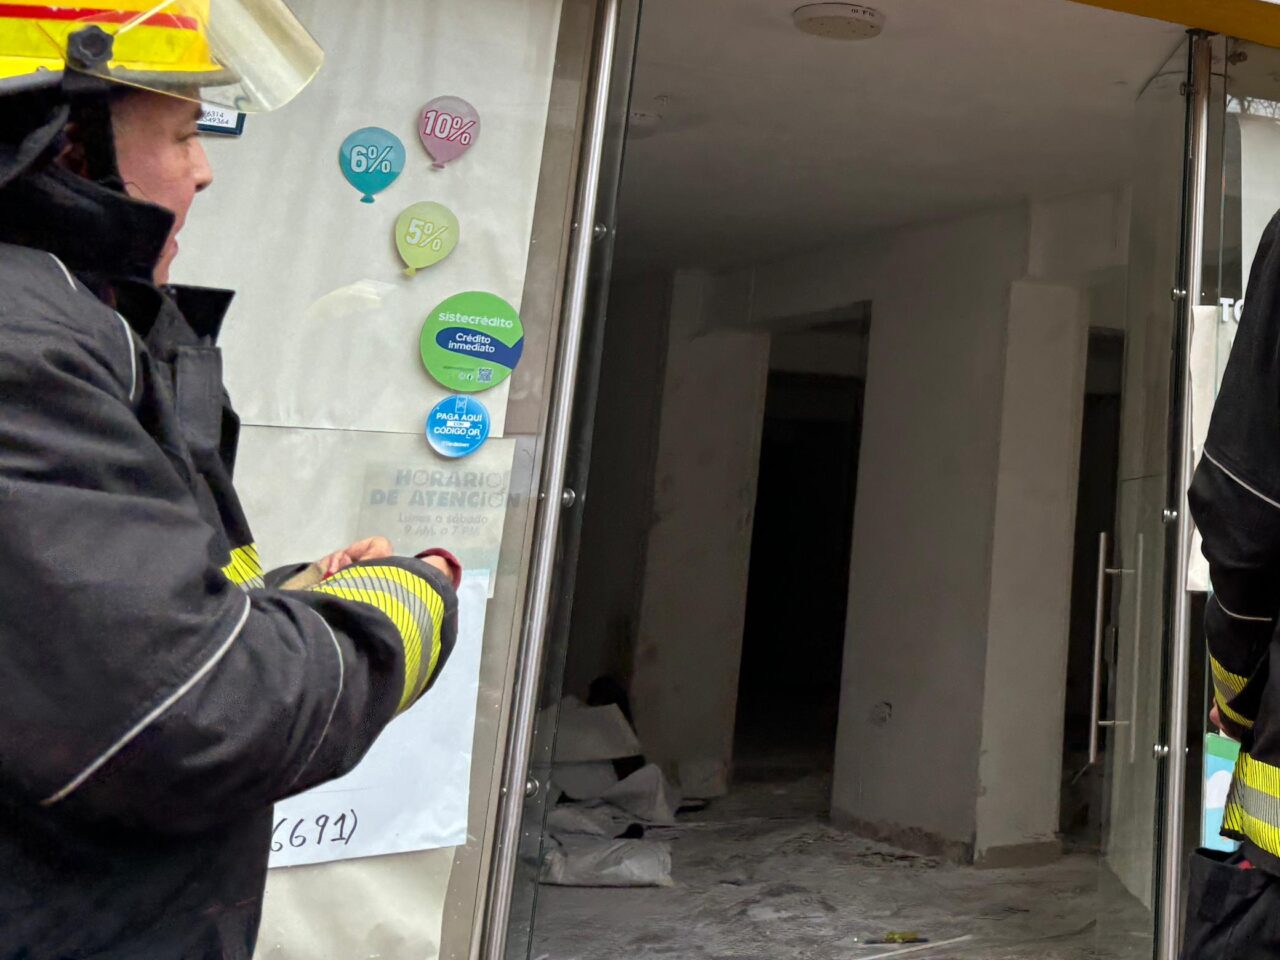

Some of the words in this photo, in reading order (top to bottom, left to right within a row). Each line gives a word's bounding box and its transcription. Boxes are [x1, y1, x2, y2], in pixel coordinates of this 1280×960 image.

[424, 110, 475, 145] 10%
[350, 145, 393, 173] 6%
[406, 218, 448, 251] 5%
[438, 311, 513, 329] sistecrédito
[448, 340, 495, 353] inmediato
[455, 332, 491, 344] Crédito
[436, 412, 459, 421] PAGA
[396, 469, 502, 489] HORARIO
[369, 488, 399, 506] DE
[408, 487, 520, 508] ATENCIÓN
